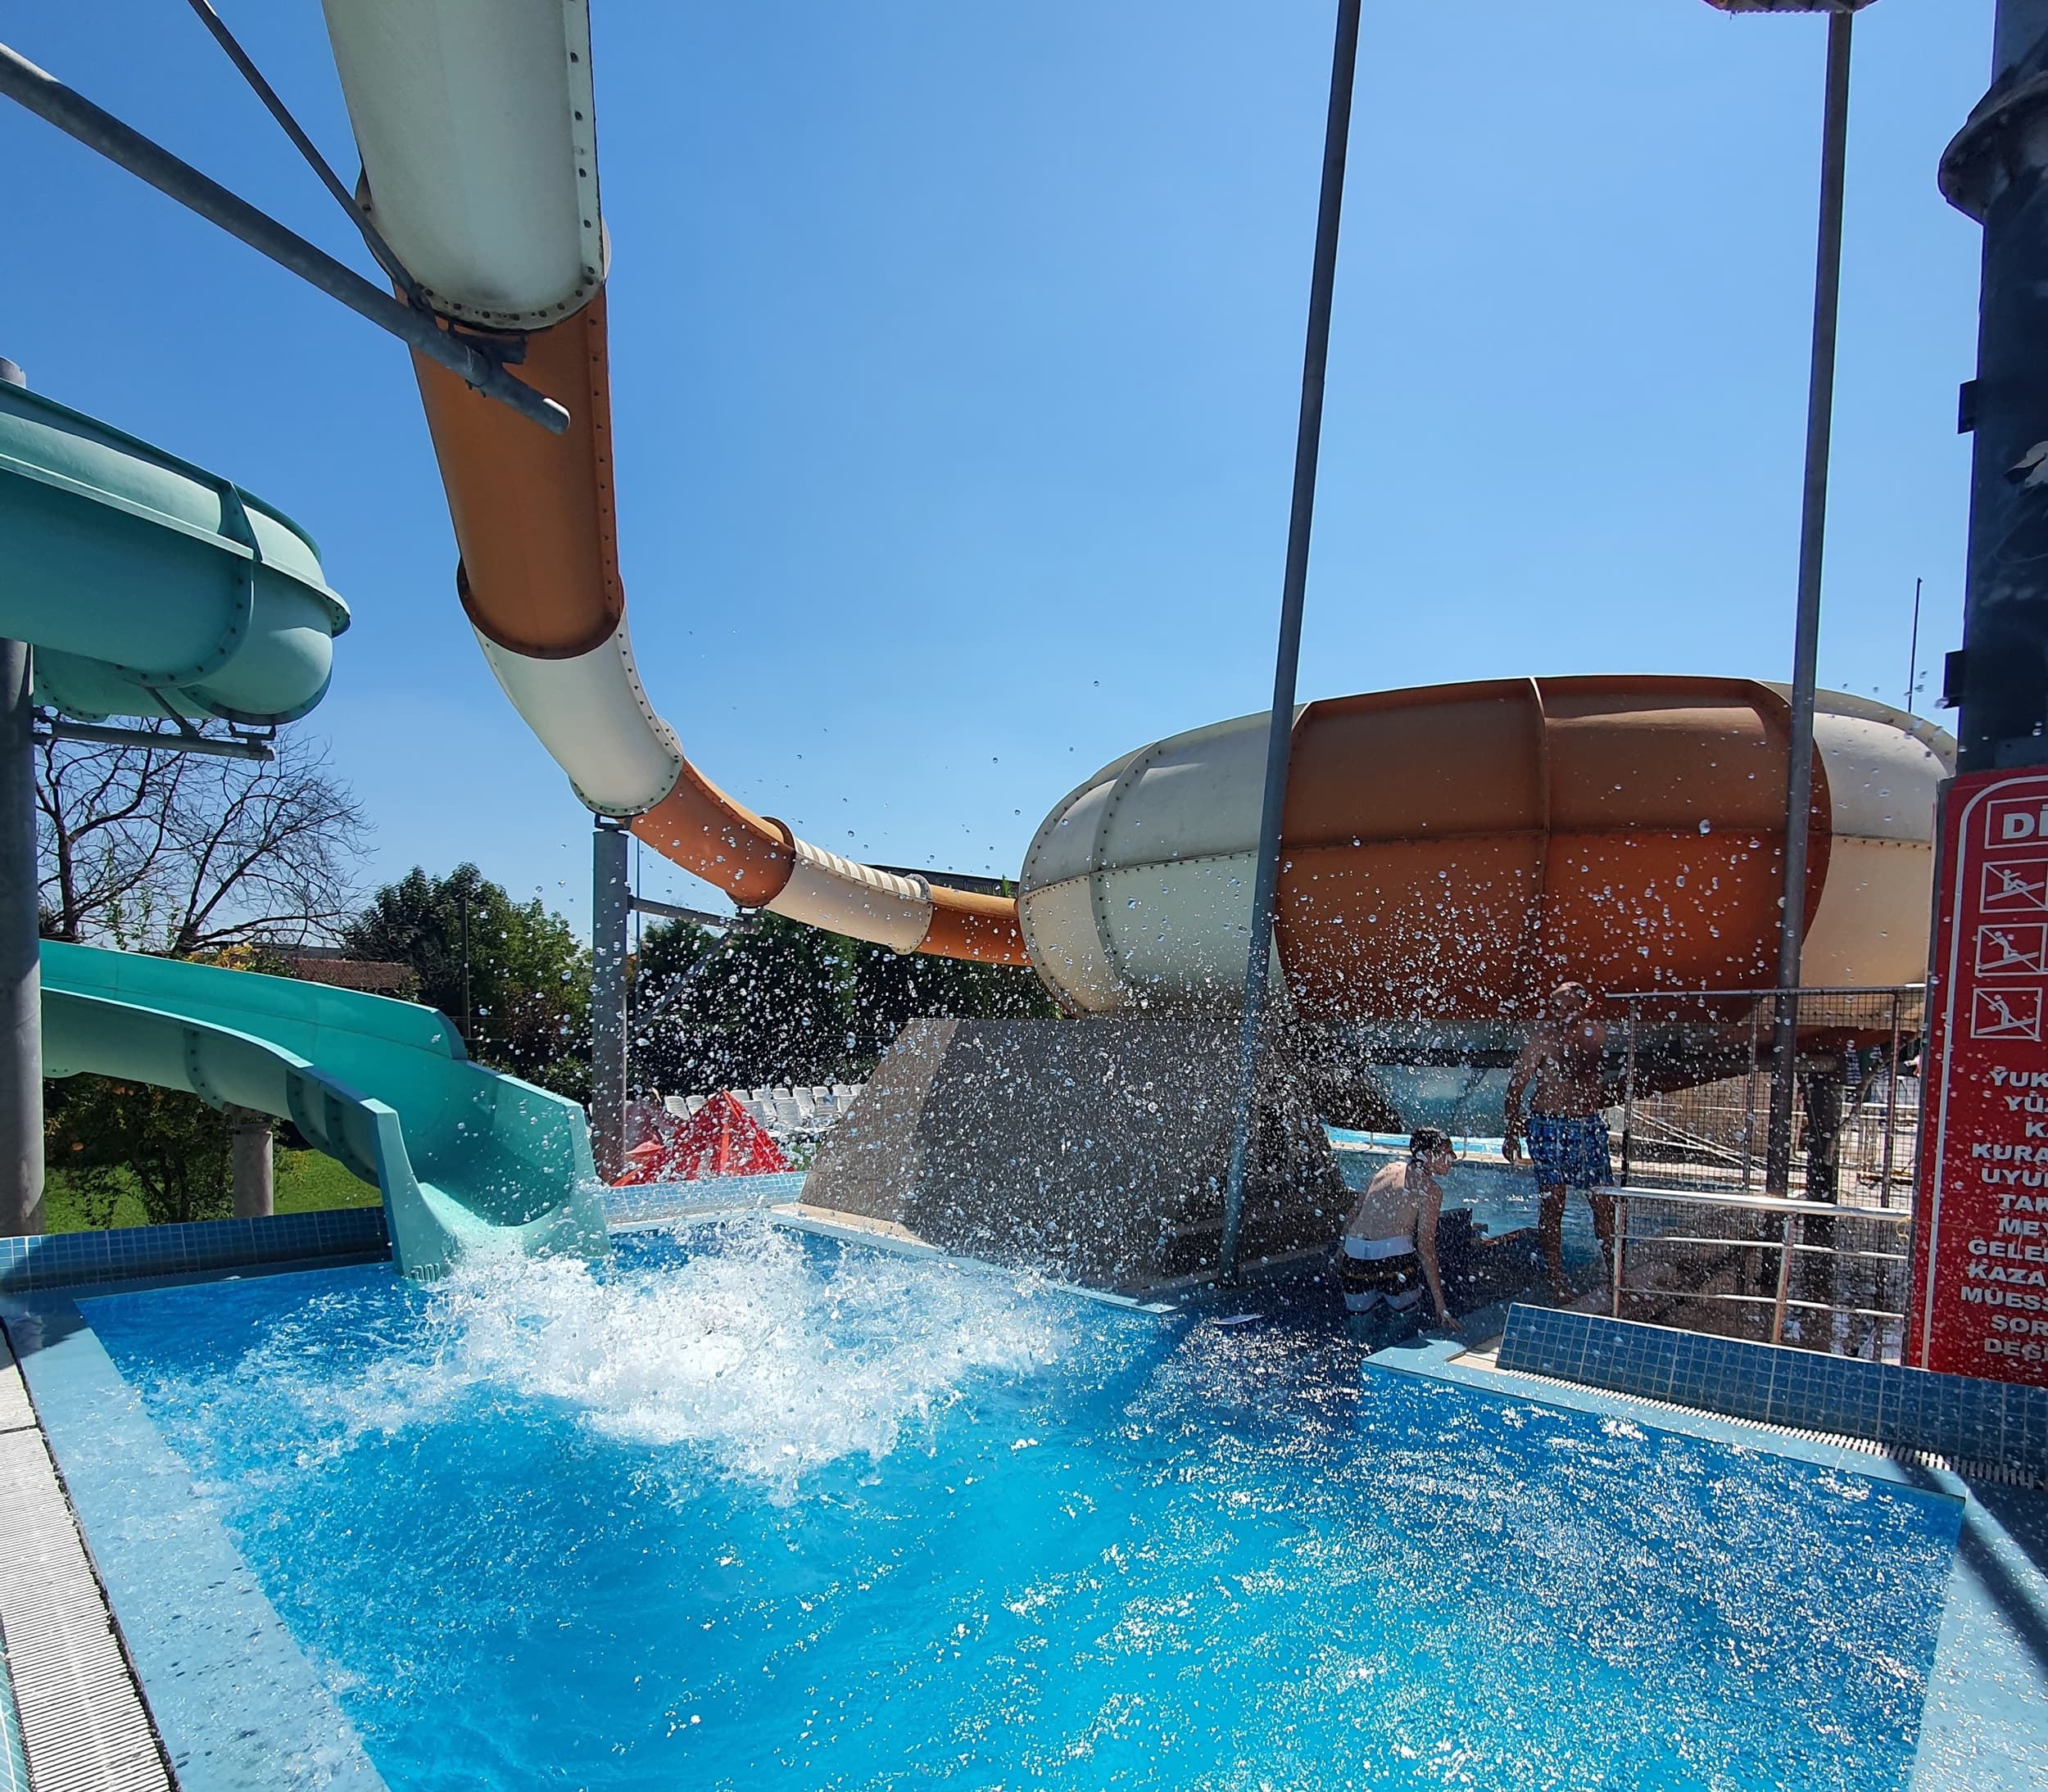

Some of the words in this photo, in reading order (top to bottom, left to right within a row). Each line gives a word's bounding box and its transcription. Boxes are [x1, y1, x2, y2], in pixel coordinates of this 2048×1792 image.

[1989, 1071, 2048, 1088] YUK
[2004, 1091, 2048, 1113] YÜ
[2025, 1121, 2048, 1138] K
[1972, 1143, 2048, 1161] KURA
[1982, 1168, 2048, 1188] UYU
[1968, 1239, 2048, 1263] GELE
[1969, 1263, 2046, 1287] KAZA
[1991, 1315, 2048, 1337] SOR
